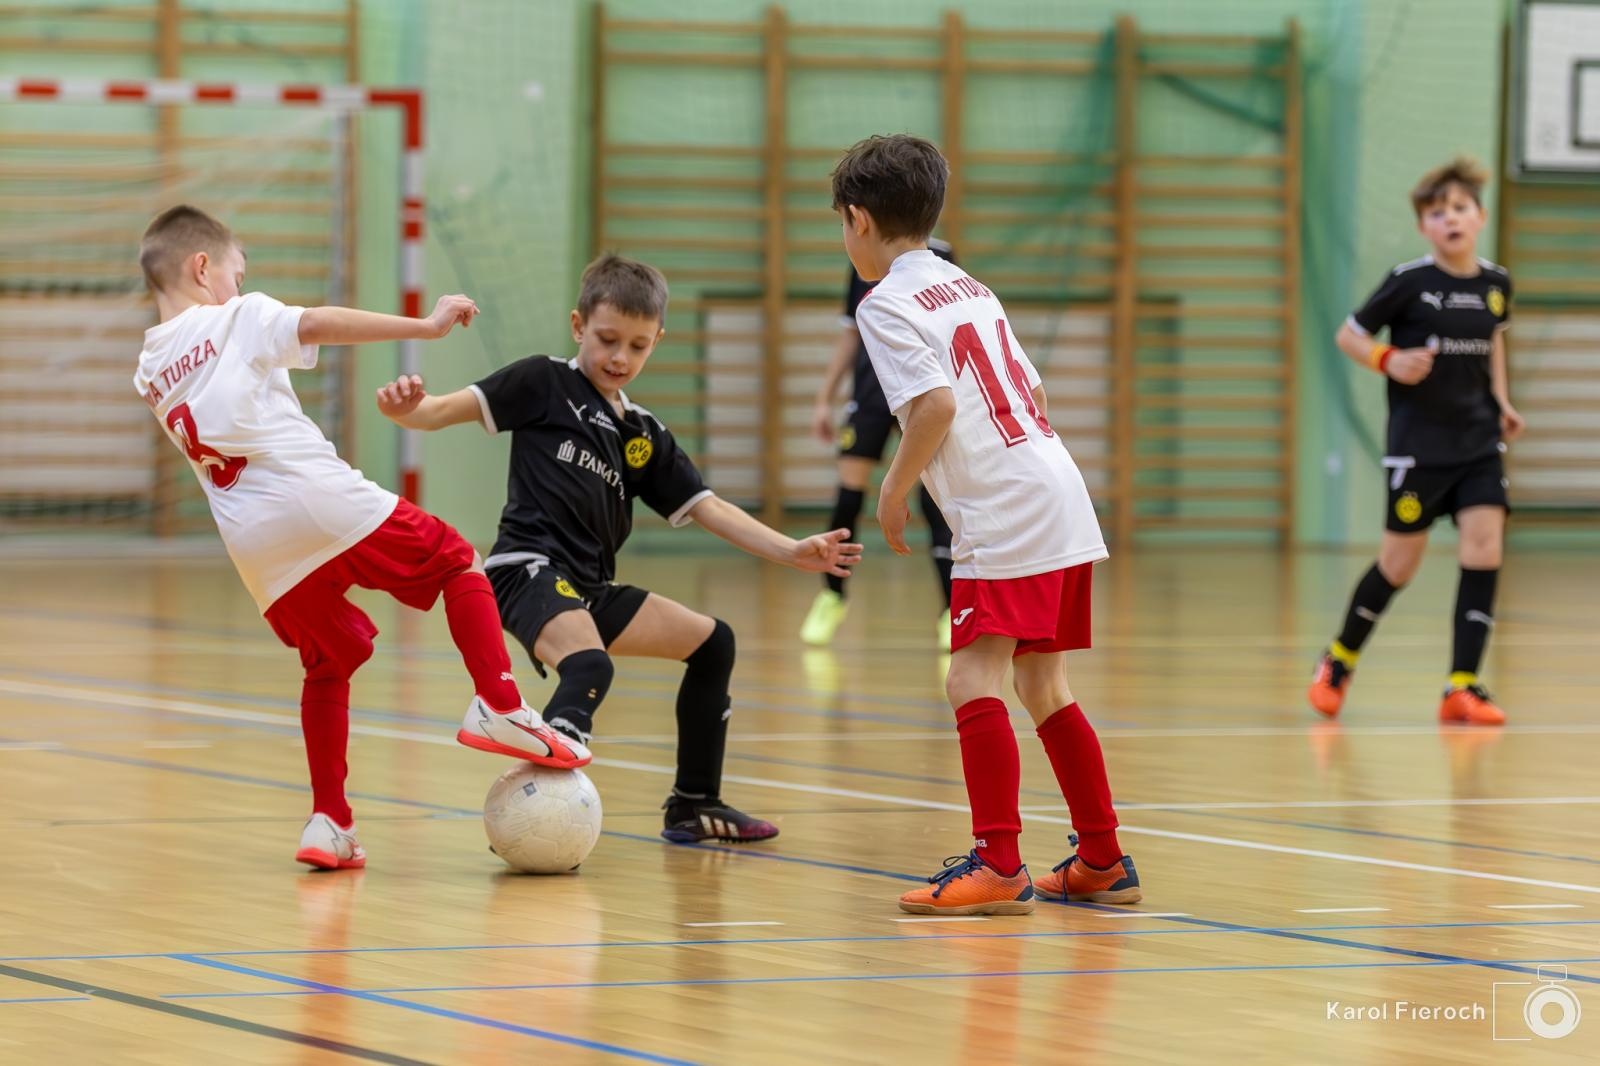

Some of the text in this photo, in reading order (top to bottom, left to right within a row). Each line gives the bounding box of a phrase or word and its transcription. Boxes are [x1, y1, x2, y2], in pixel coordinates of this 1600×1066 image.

[913, 282, 963, 312] UNIA
[160, 339, 217, 391] TURZA
[950, 318, 1054, 448] 16
